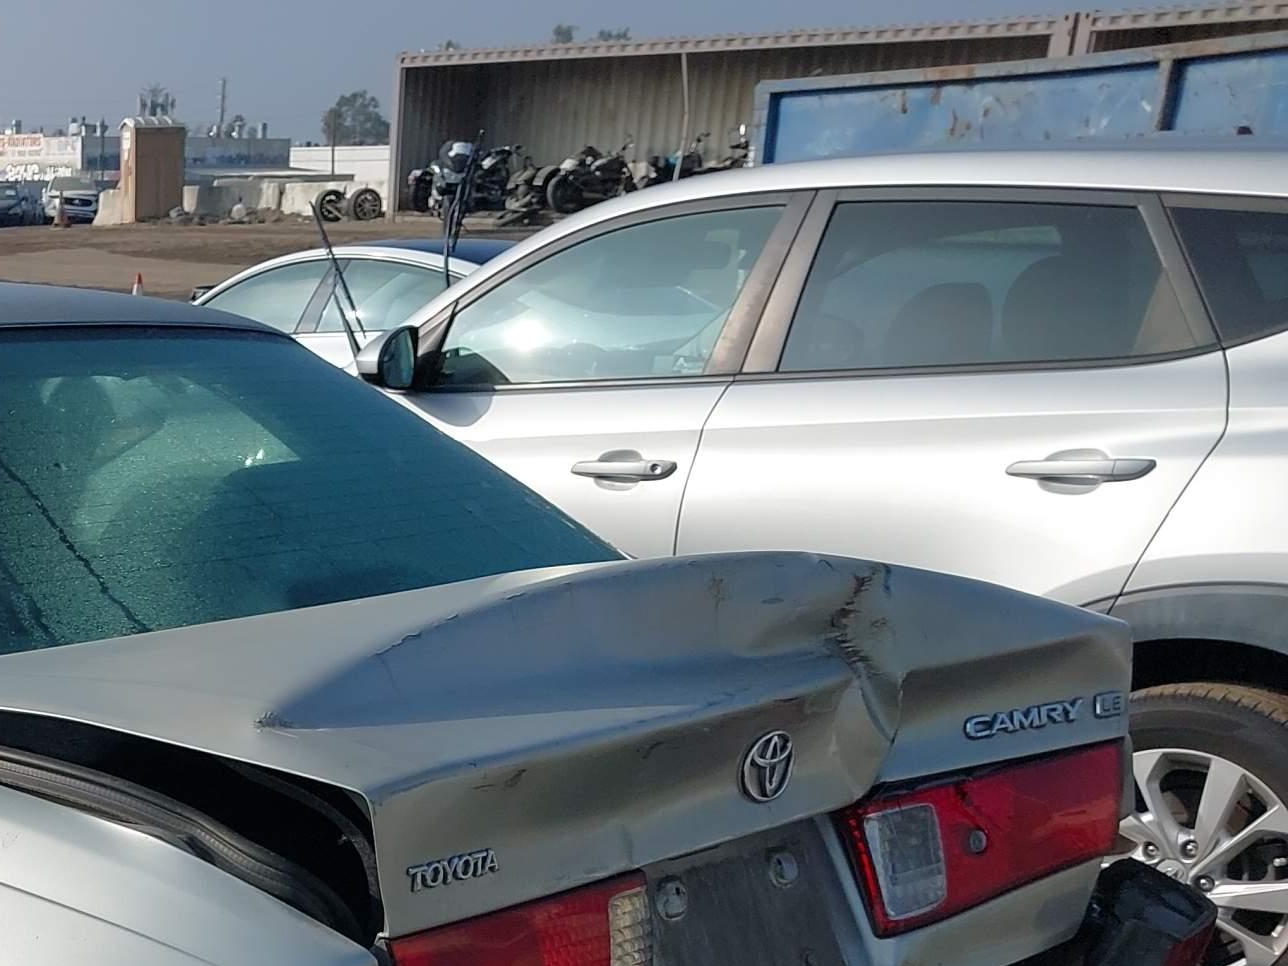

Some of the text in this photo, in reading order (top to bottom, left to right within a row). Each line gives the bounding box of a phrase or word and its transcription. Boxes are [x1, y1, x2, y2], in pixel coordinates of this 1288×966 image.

[964, 693, 1123, 740] CAMRY LE
[407, 848, 499, 892] TOYOTA
